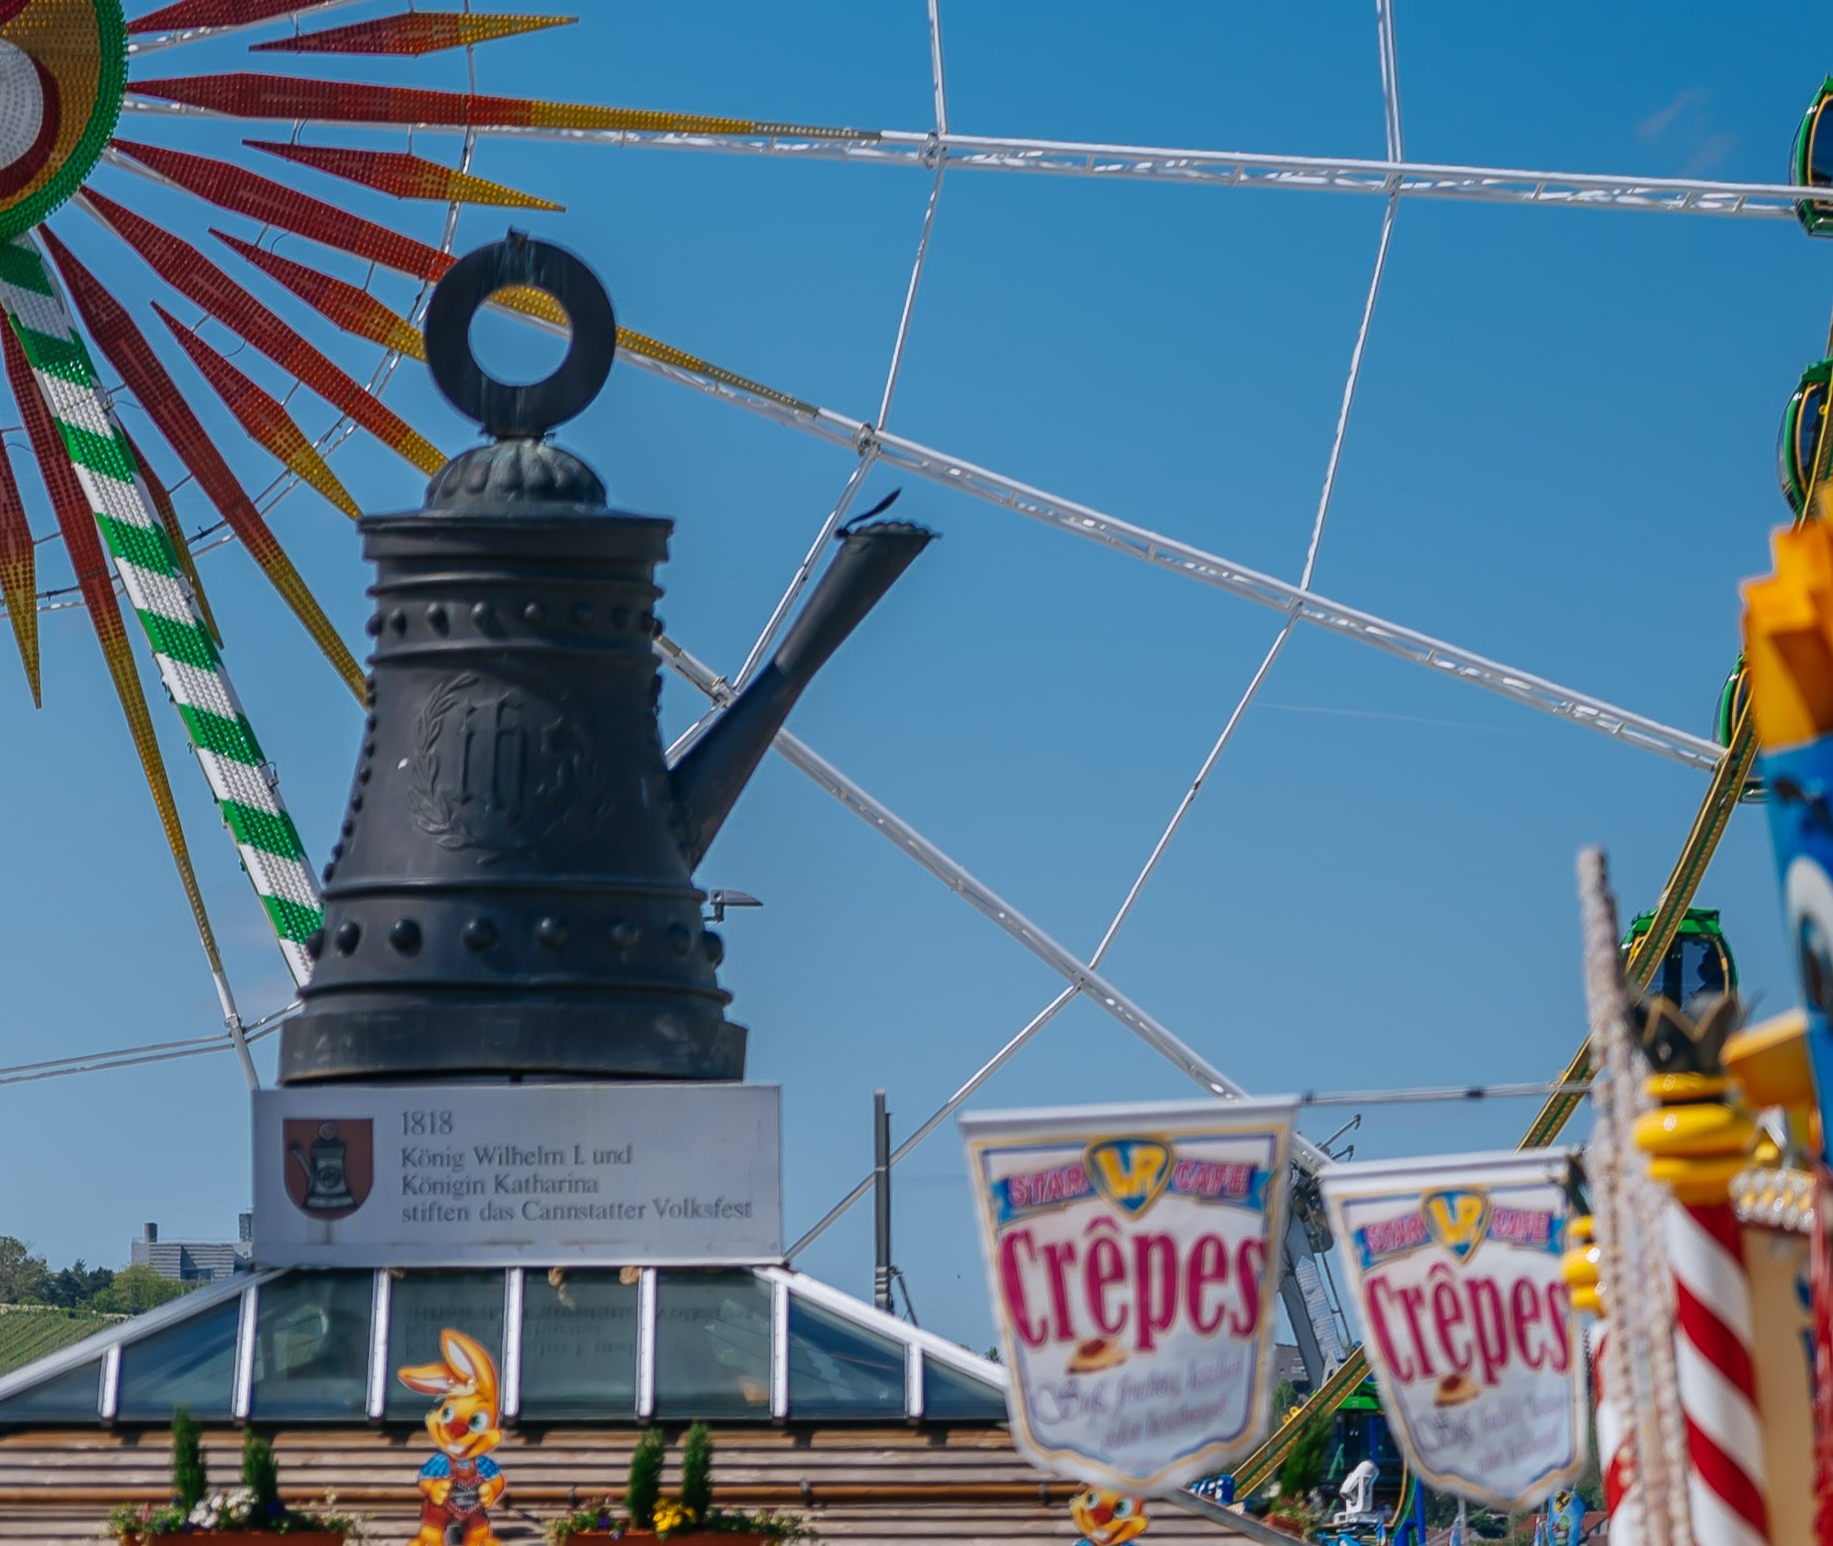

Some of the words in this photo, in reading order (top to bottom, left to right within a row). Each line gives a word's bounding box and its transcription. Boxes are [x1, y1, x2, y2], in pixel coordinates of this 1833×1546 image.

[400, 1110, 454, 1137] 1818
[400, 1146, 465, 1170] König
[473, 1145, 564, 1168] Wilhelm
[592, 1144, 633, 1165] und
[400, 1174, 486, 1199] Königin
[493, 1173, 599, 1195] Katharina
[1008, 1162, 1090, 1203] STAR
[400, 1200, 471, 1223] stiften
[479, 1200, 515, 1222] das
[521, 1200, 647, 1222] Cannstatter
[653, 1197, 754, 1220] Volksfest
[997, 1215, 1269, 1353] Crêpes
[1364, 1261, 1571, 1385] Crêpes
